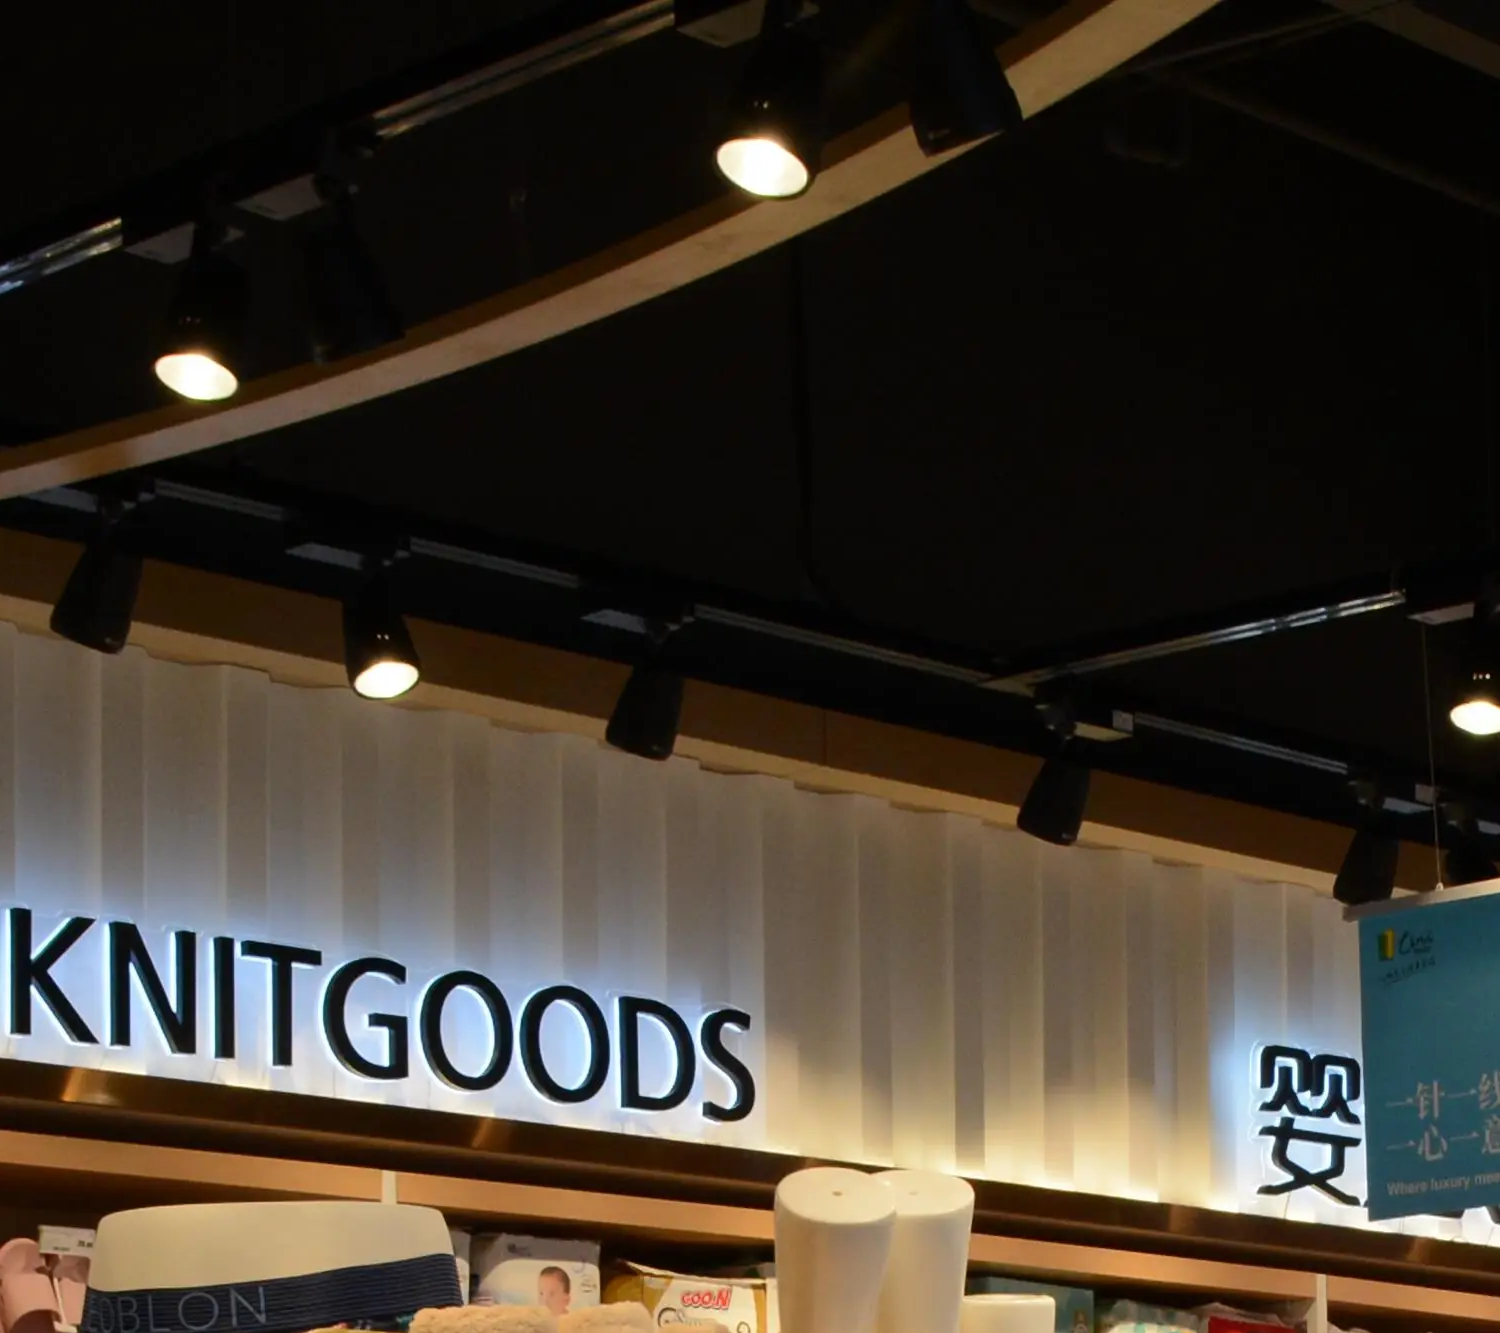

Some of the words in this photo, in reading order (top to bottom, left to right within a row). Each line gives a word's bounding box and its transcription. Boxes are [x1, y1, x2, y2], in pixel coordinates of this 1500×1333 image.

[8, 907, 757, 1124] KNITGOODS
[1386, 1177, 1428, 1196] Where
[1430, 1174, 1471, 1191] luxury
